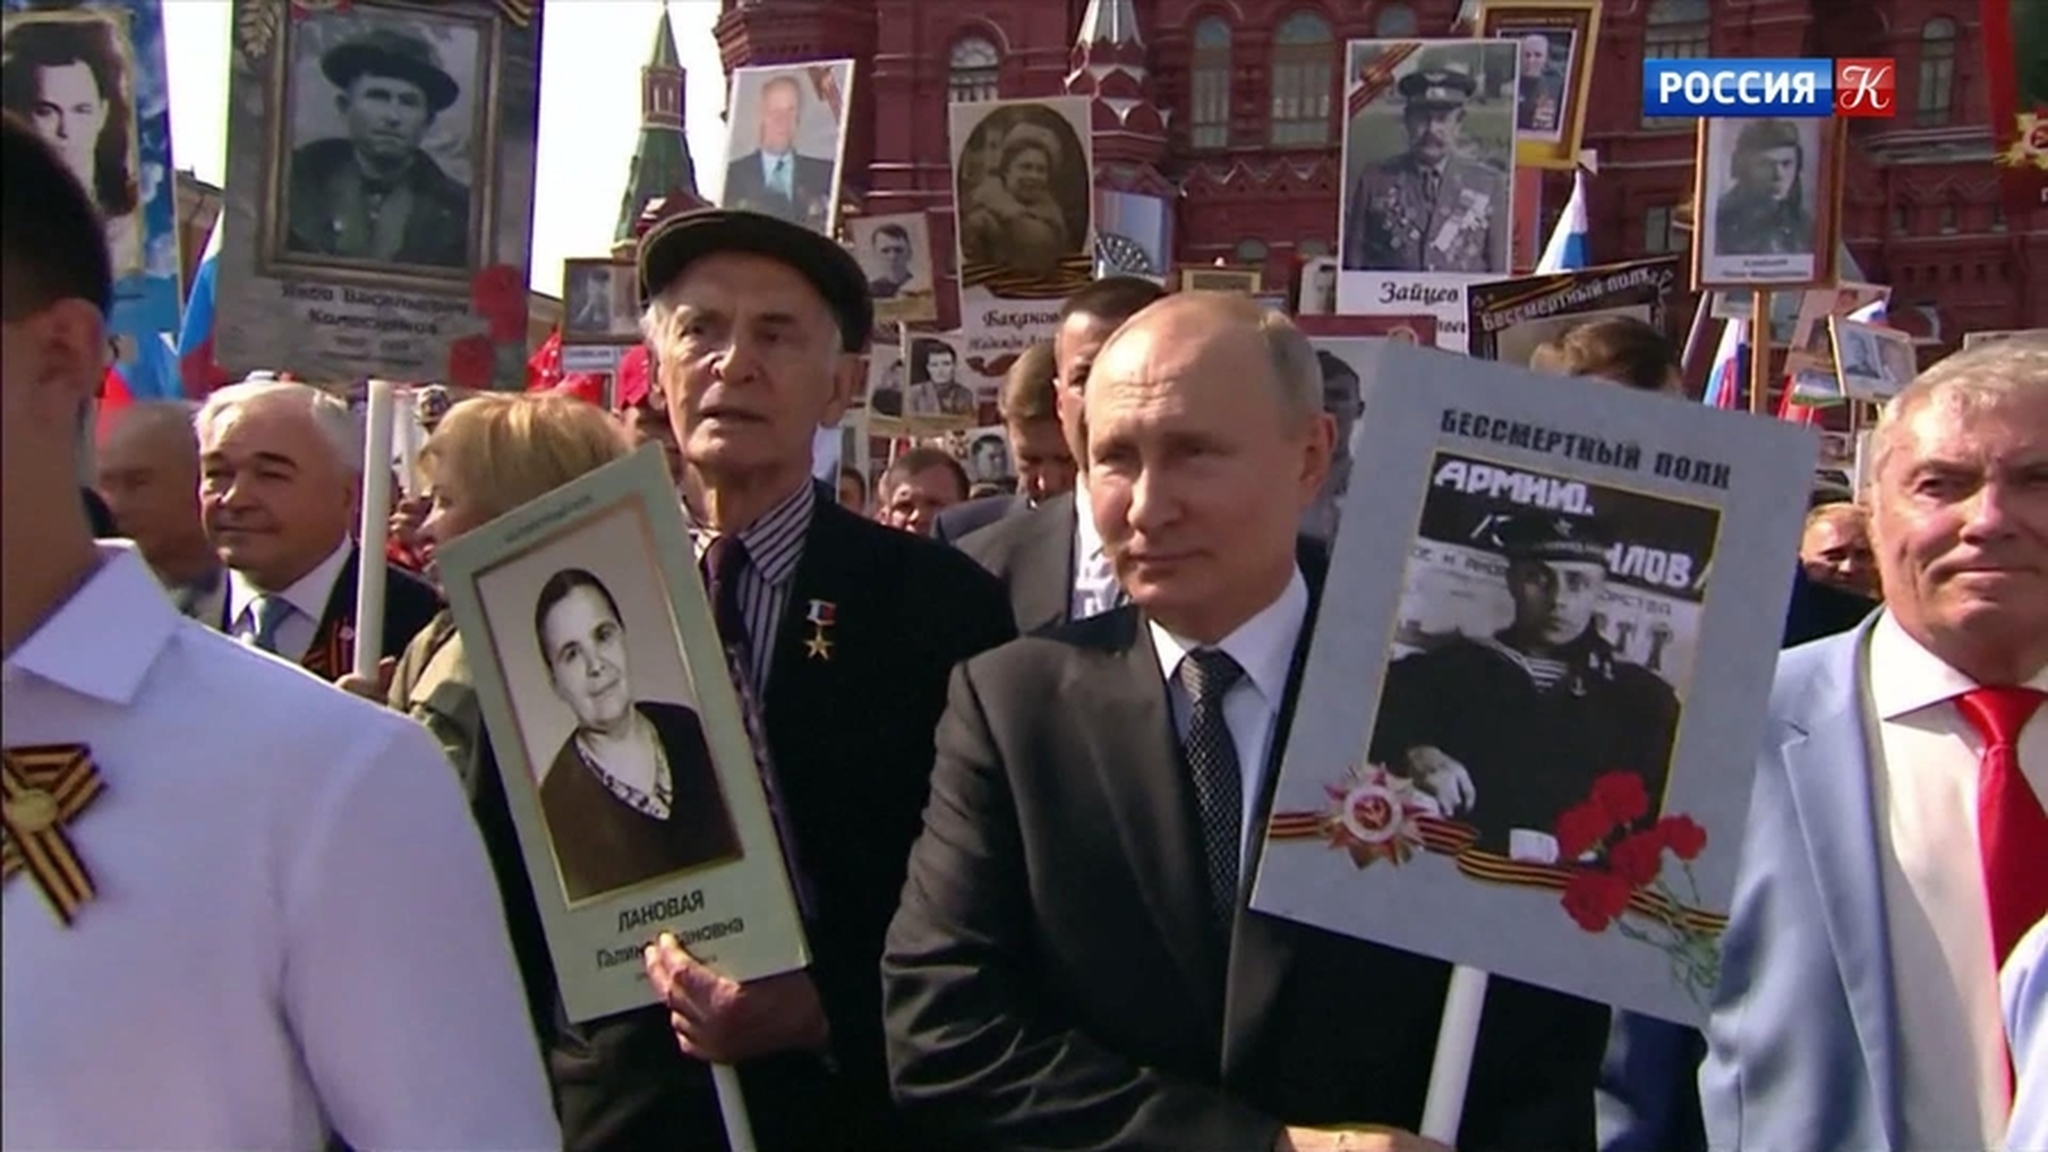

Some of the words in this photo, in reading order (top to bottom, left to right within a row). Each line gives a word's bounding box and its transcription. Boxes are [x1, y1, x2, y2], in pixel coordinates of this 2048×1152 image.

[1378, 281, 1459, 306] Зайцев
[1440, 408, 1642, 470] БЕССМЕРТНЫЙ
[1654, 451, 1731, 489] ПОЛК
[1434, 460, 1594, 515] АРМИЮ.
[618, 889, 705, 933] ЛАНОВАЯ
